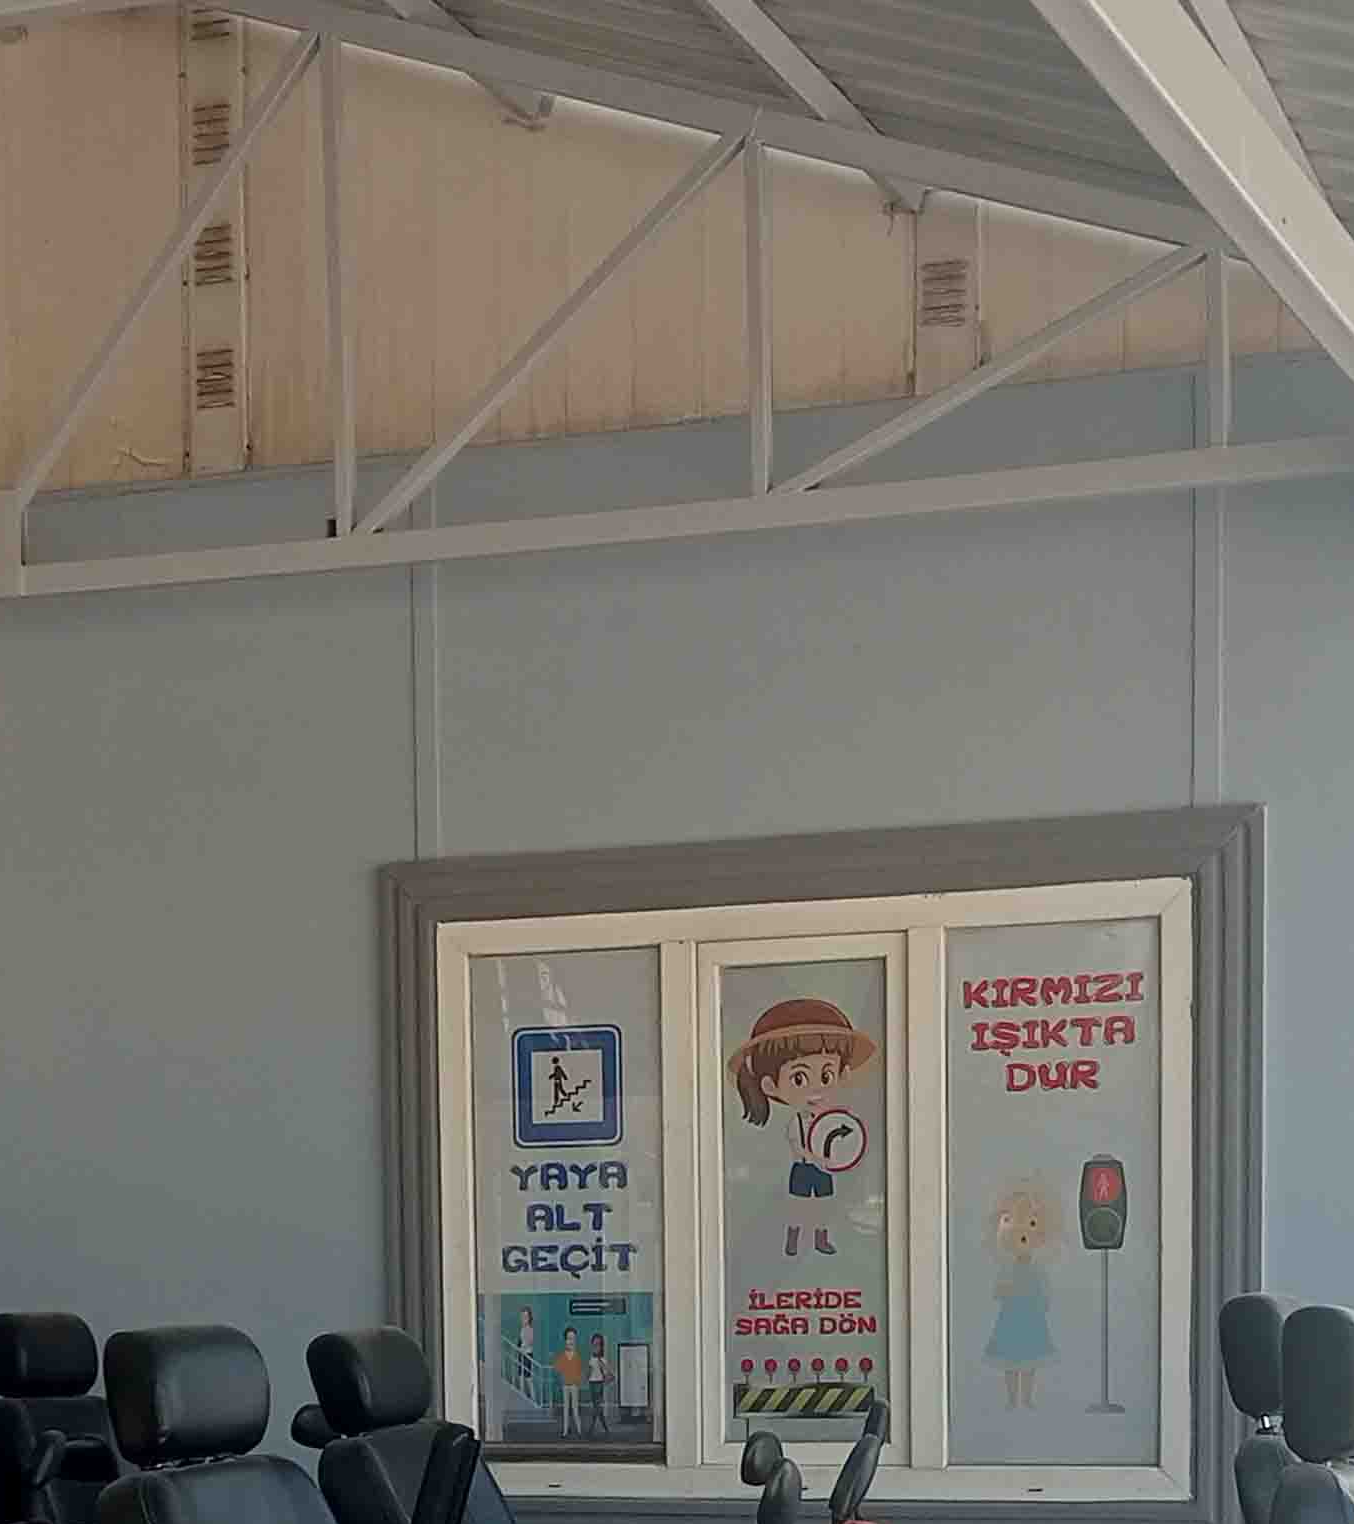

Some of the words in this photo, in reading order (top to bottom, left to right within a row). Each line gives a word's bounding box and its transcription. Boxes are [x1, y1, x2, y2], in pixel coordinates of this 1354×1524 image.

[963, 971, 1145, 1009] KIRMIZI
[970, 1015, 1136, 1057] IŞIKTA
[1004, 1059, 1100, 1093] DUR
[510, 1160, 629, 1191] YAYA
[526, 1203, 613, 1233] ALT
[501, 1236, 637, 1279] GEÇİT
[748, 1286, 862, 1311] İLERİDE
[735, 1313, 810, 1337] SAĞA
[819, 1312, 877, 1335] DÖN
